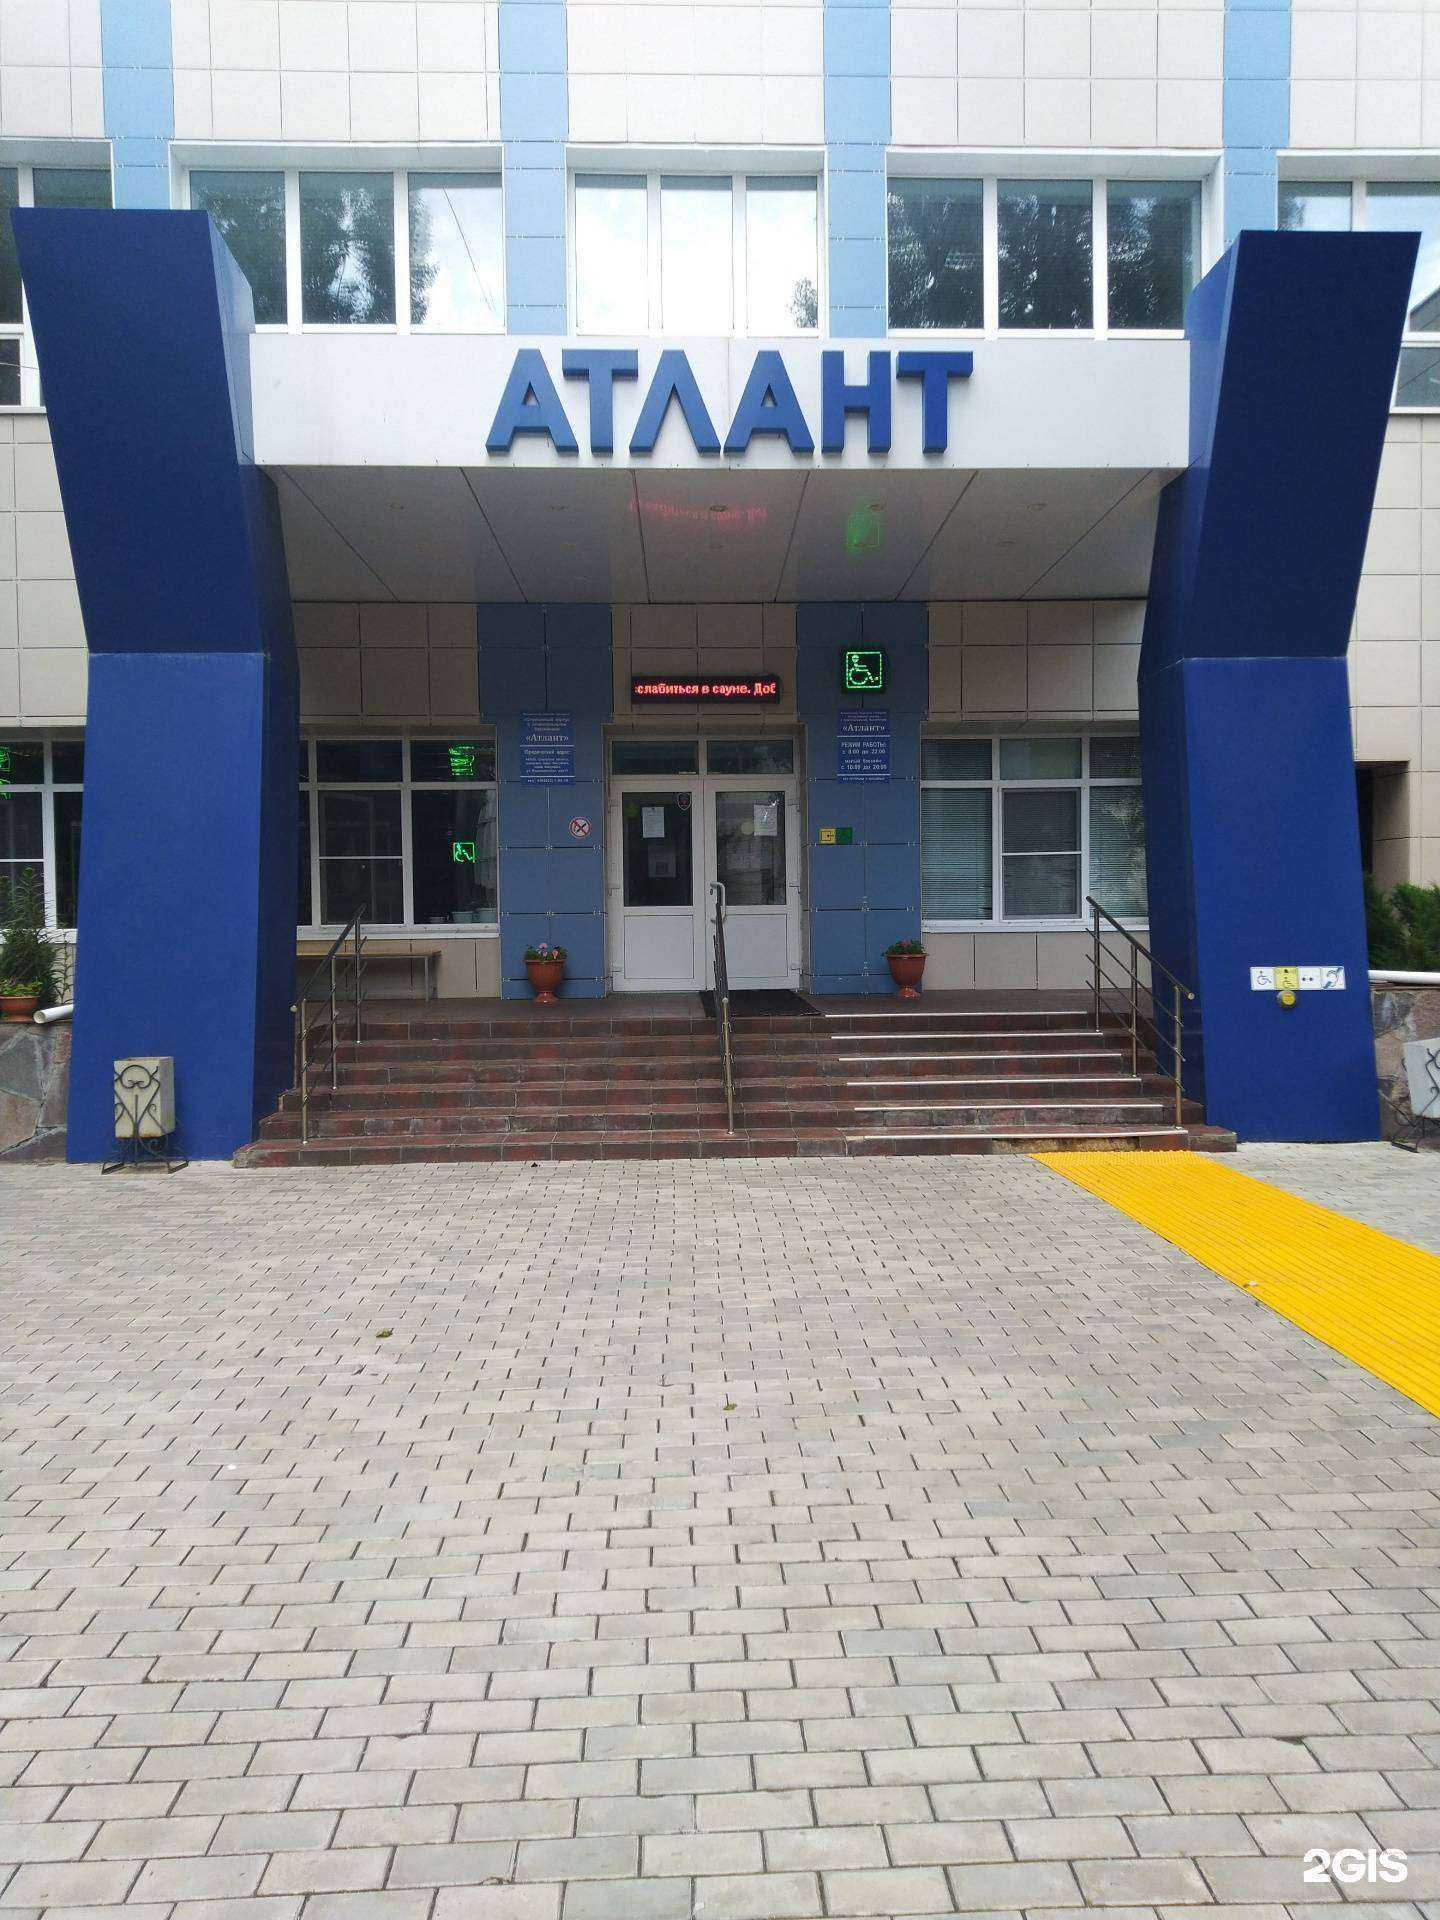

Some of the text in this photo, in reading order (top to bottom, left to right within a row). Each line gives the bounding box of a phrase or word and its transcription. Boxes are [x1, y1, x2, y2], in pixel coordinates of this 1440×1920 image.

[486, 348, 974, 454] АТЛАНТ
[634, 683, 699, 695] слабиться
[701, 685, 710, 695] в
[712, 685, 751, 696] сауне.
